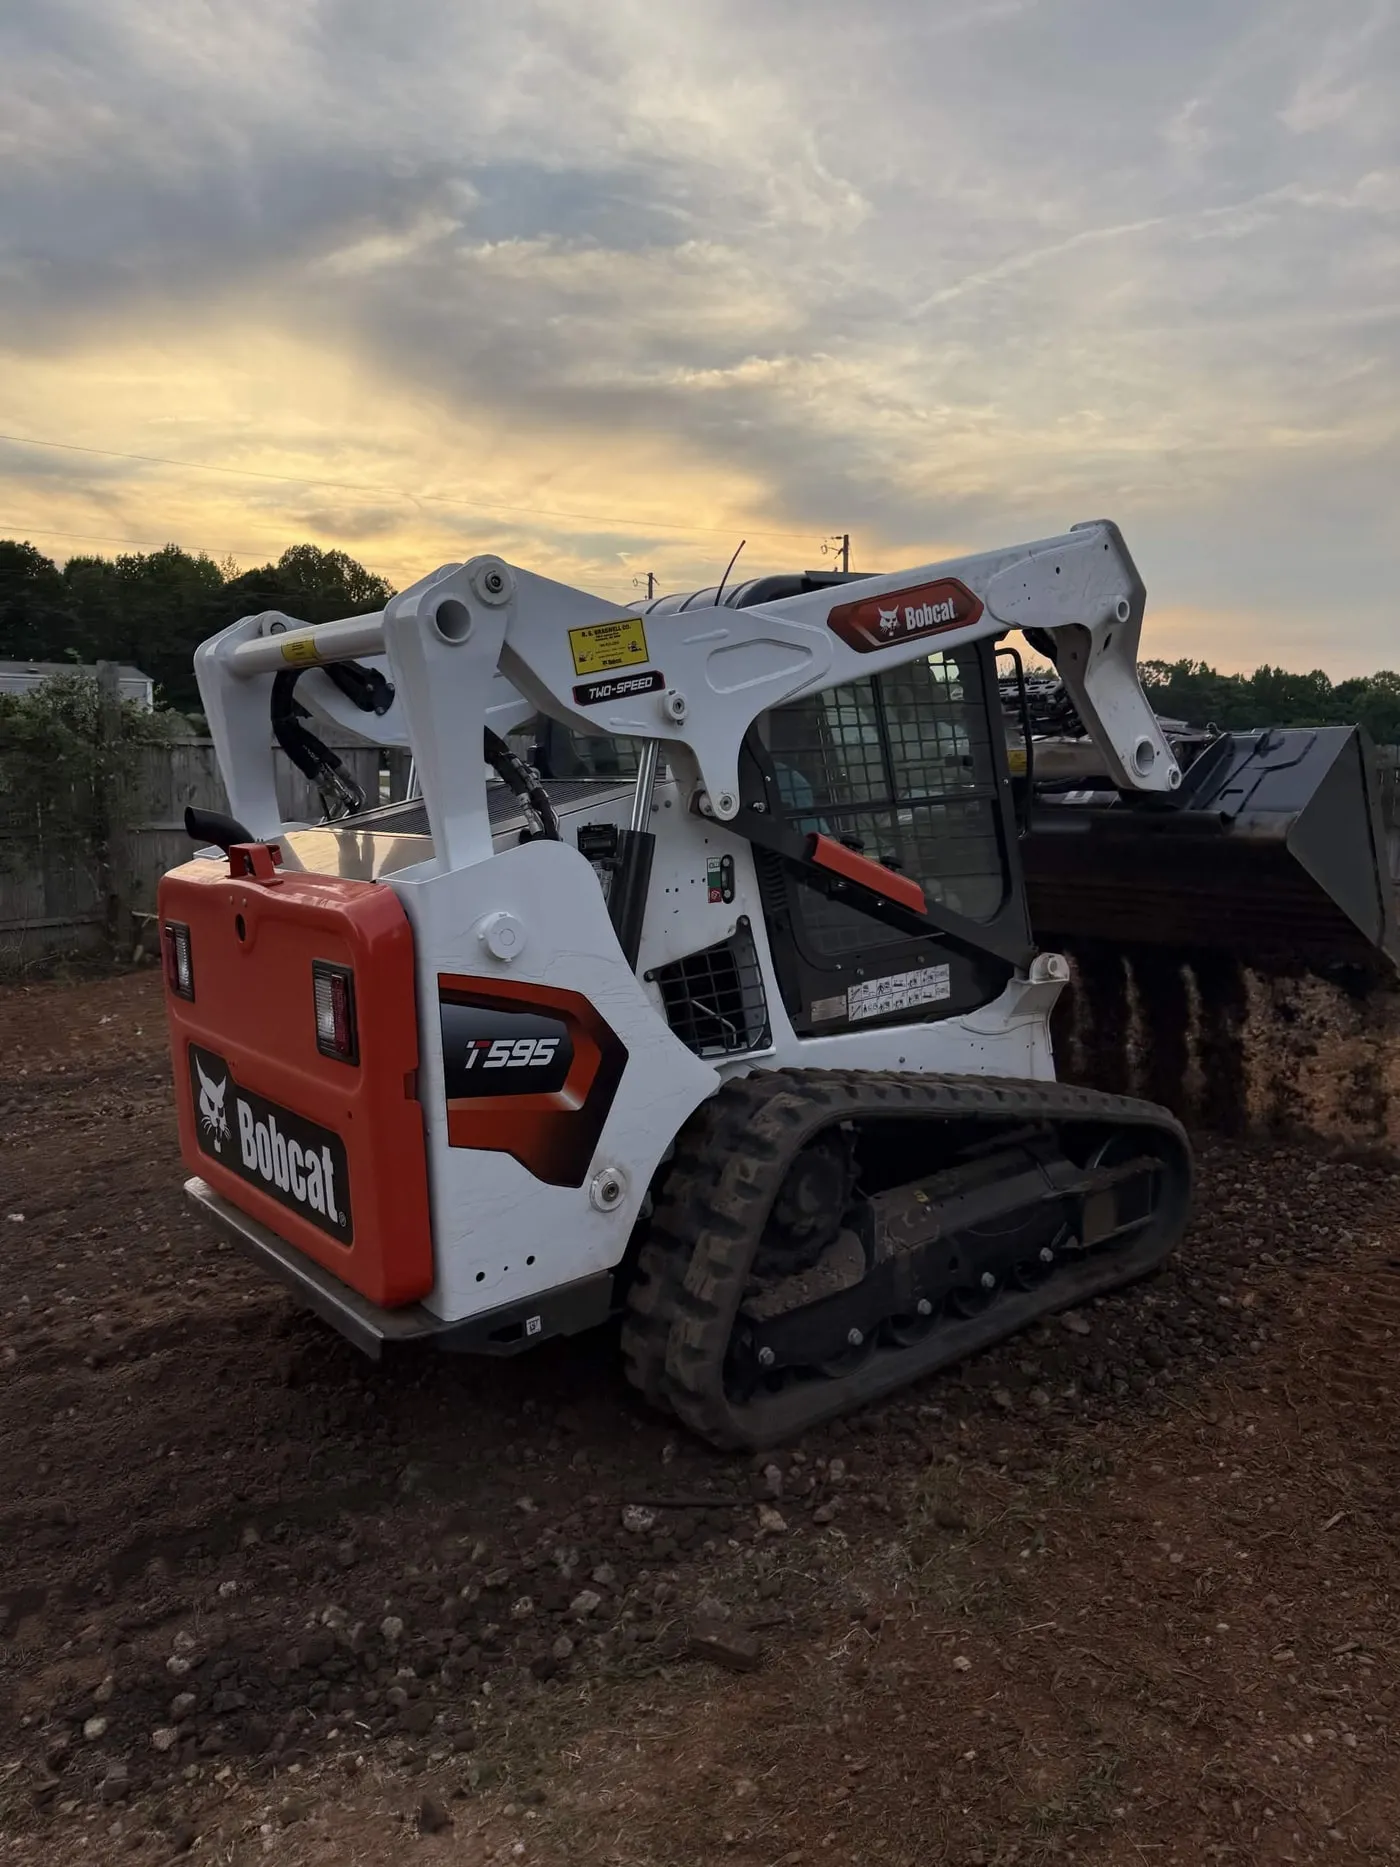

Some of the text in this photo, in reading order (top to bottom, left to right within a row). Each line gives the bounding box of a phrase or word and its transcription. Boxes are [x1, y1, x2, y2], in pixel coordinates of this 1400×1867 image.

[904, 597, 956, 631] Bobcat
[588, 676, 654, 700] TWO-SPEED
[464, 1038, 561, 1069] T595
[236, 1097, 339, 1224] Bobcat
